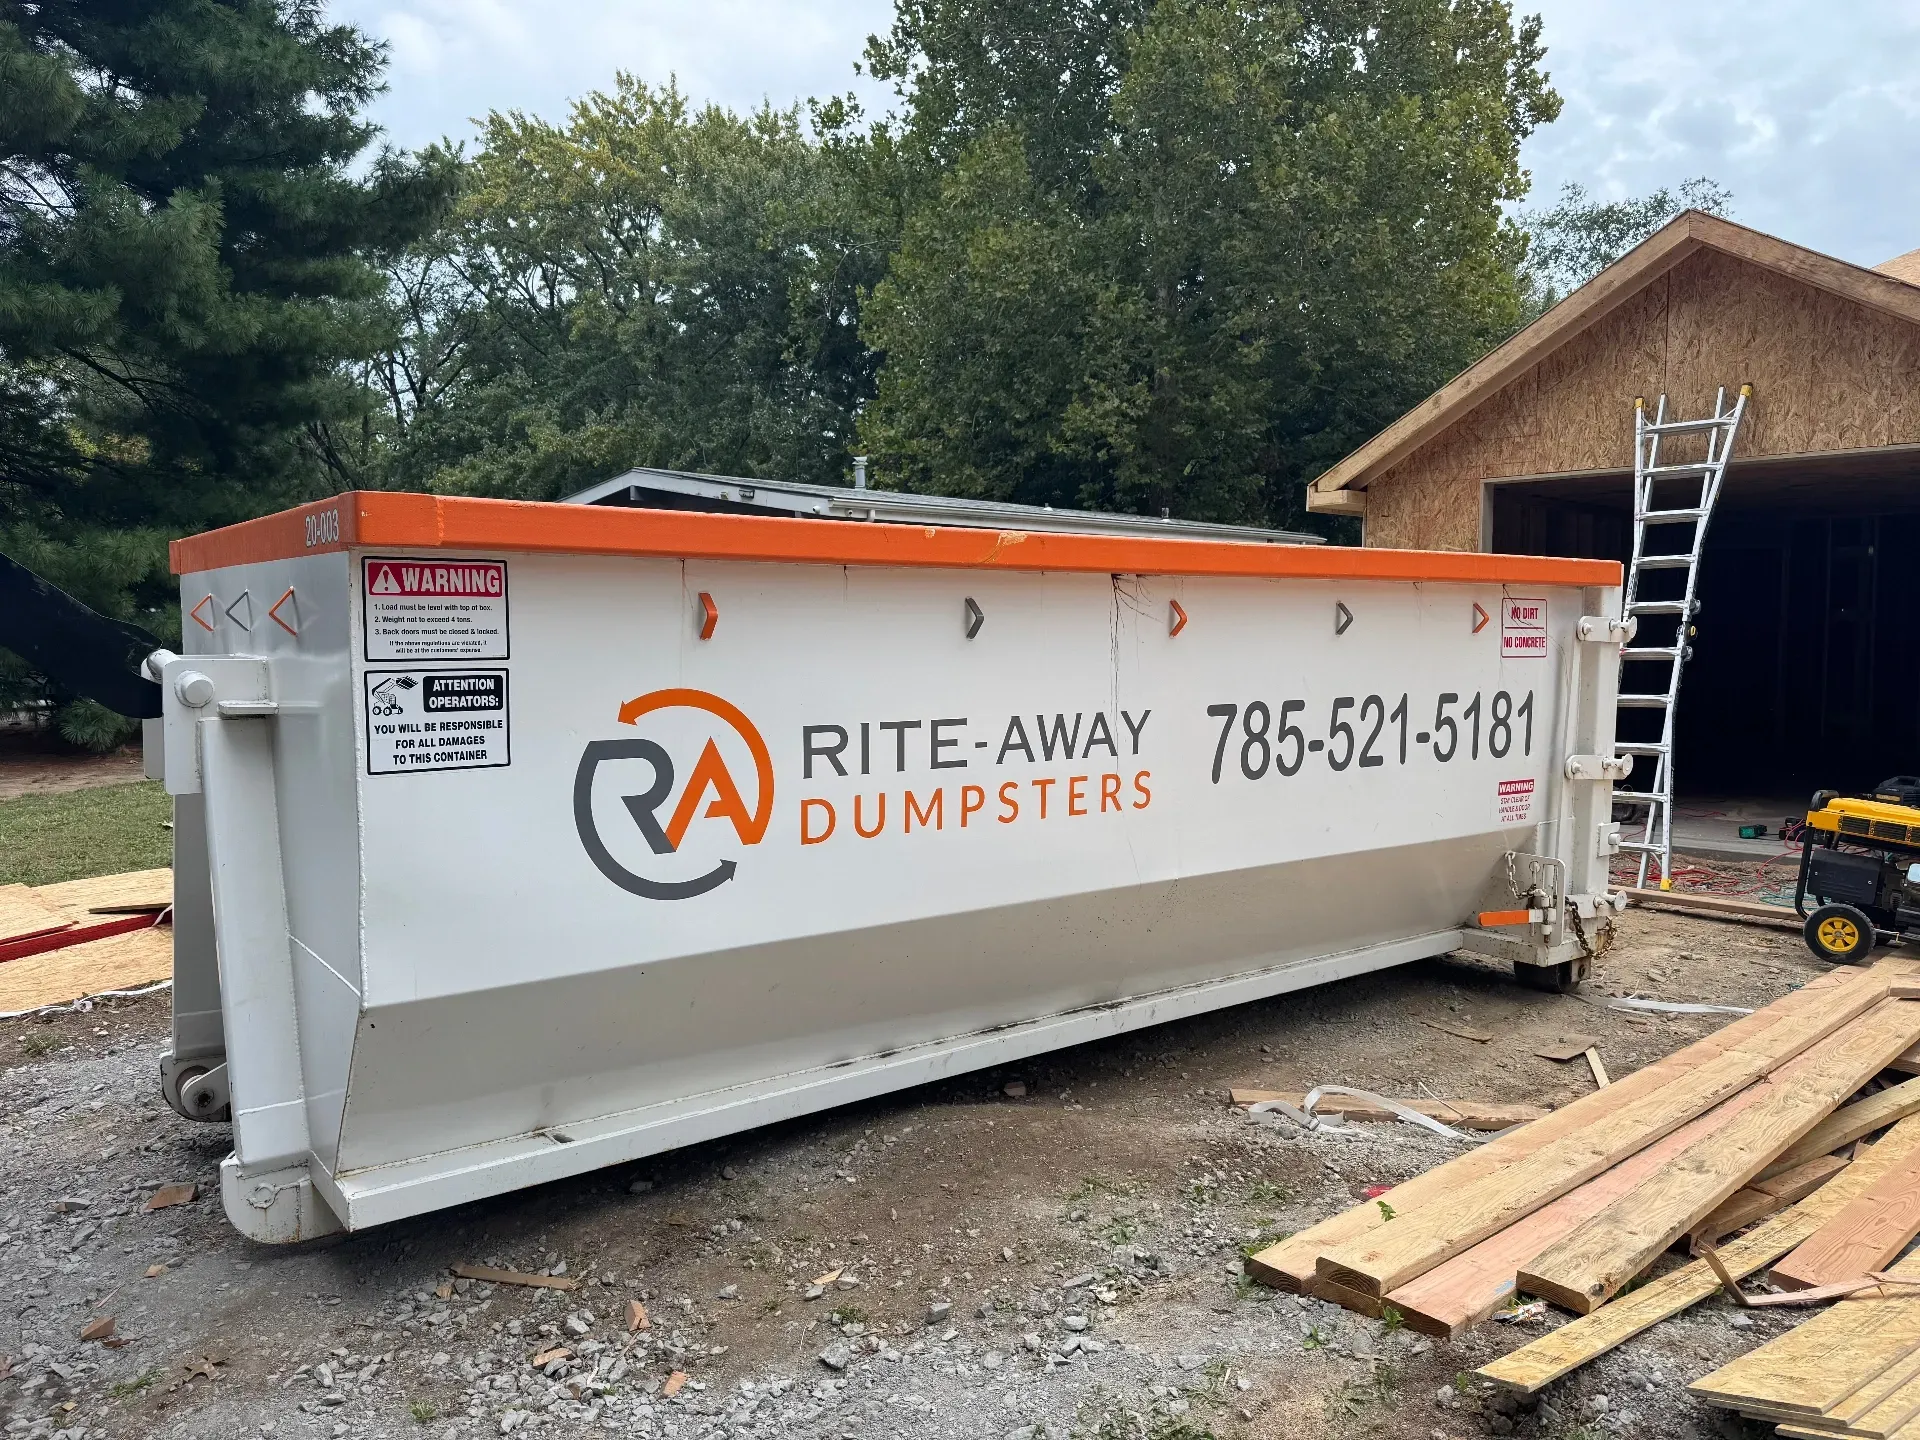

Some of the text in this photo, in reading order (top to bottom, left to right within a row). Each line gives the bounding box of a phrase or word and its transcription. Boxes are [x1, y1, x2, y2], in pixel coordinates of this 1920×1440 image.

[306, 509, 339, 547] 20-003
[402, 567, 500, 594] WARNING
[1511, 607, 1538, 619] NO DIRT
[382, 616, 405, 624] Weight
[1504, 637, 1545, 648] NO CONCRETE
[433, 679, 494, 691] ATTENTION
[429, 695, 498, 708] OPERATORS:
[375, 720, 503, 734] YOU WILL BE RESPONSIBLE
[396, 736, 485, 749] FOR ALL DAMAGES
[1207, 690, 1534, 784] 785-521-5181
[802, 710, 1152, 778] RITE-AWAY
[393, 750, 487, 765] TO THIS CONTAINER
[1500, 782, 1533, 793] WARNING
[800, 770, 1152, 846] DUMPSTERS
